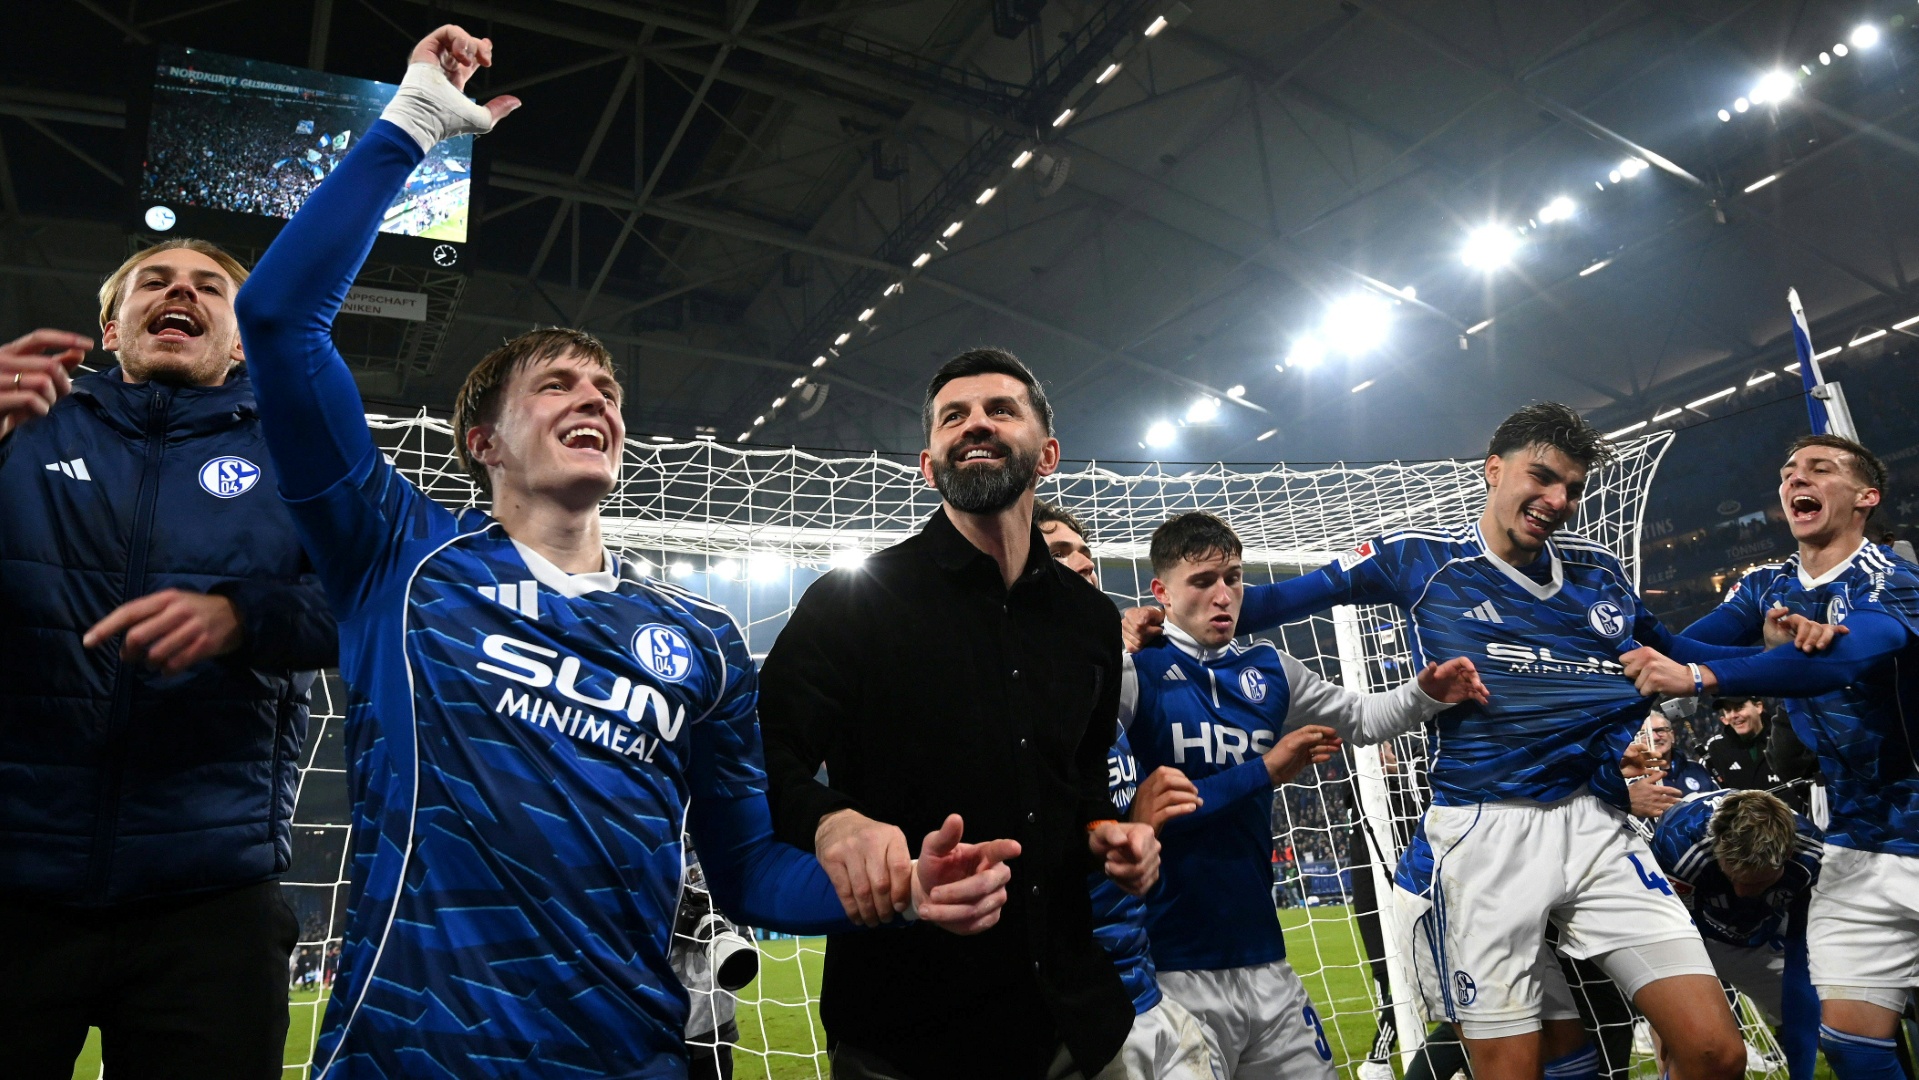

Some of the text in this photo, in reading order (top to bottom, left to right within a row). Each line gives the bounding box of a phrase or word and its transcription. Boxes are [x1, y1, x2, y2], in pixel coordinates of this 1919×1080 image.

[169, 66, 238, 86] NORDKURVE
[240, 78, 302, 94] GELSENKIRCHEN
[476, 634, 686, 742] SUN
[496, 688, 660, 764] MINIMEAL
[1171, 721, 1276, 766] HRS
[1627, 853, 1674, 897] 4
[1302, 1005, 1333, 1062] 3
